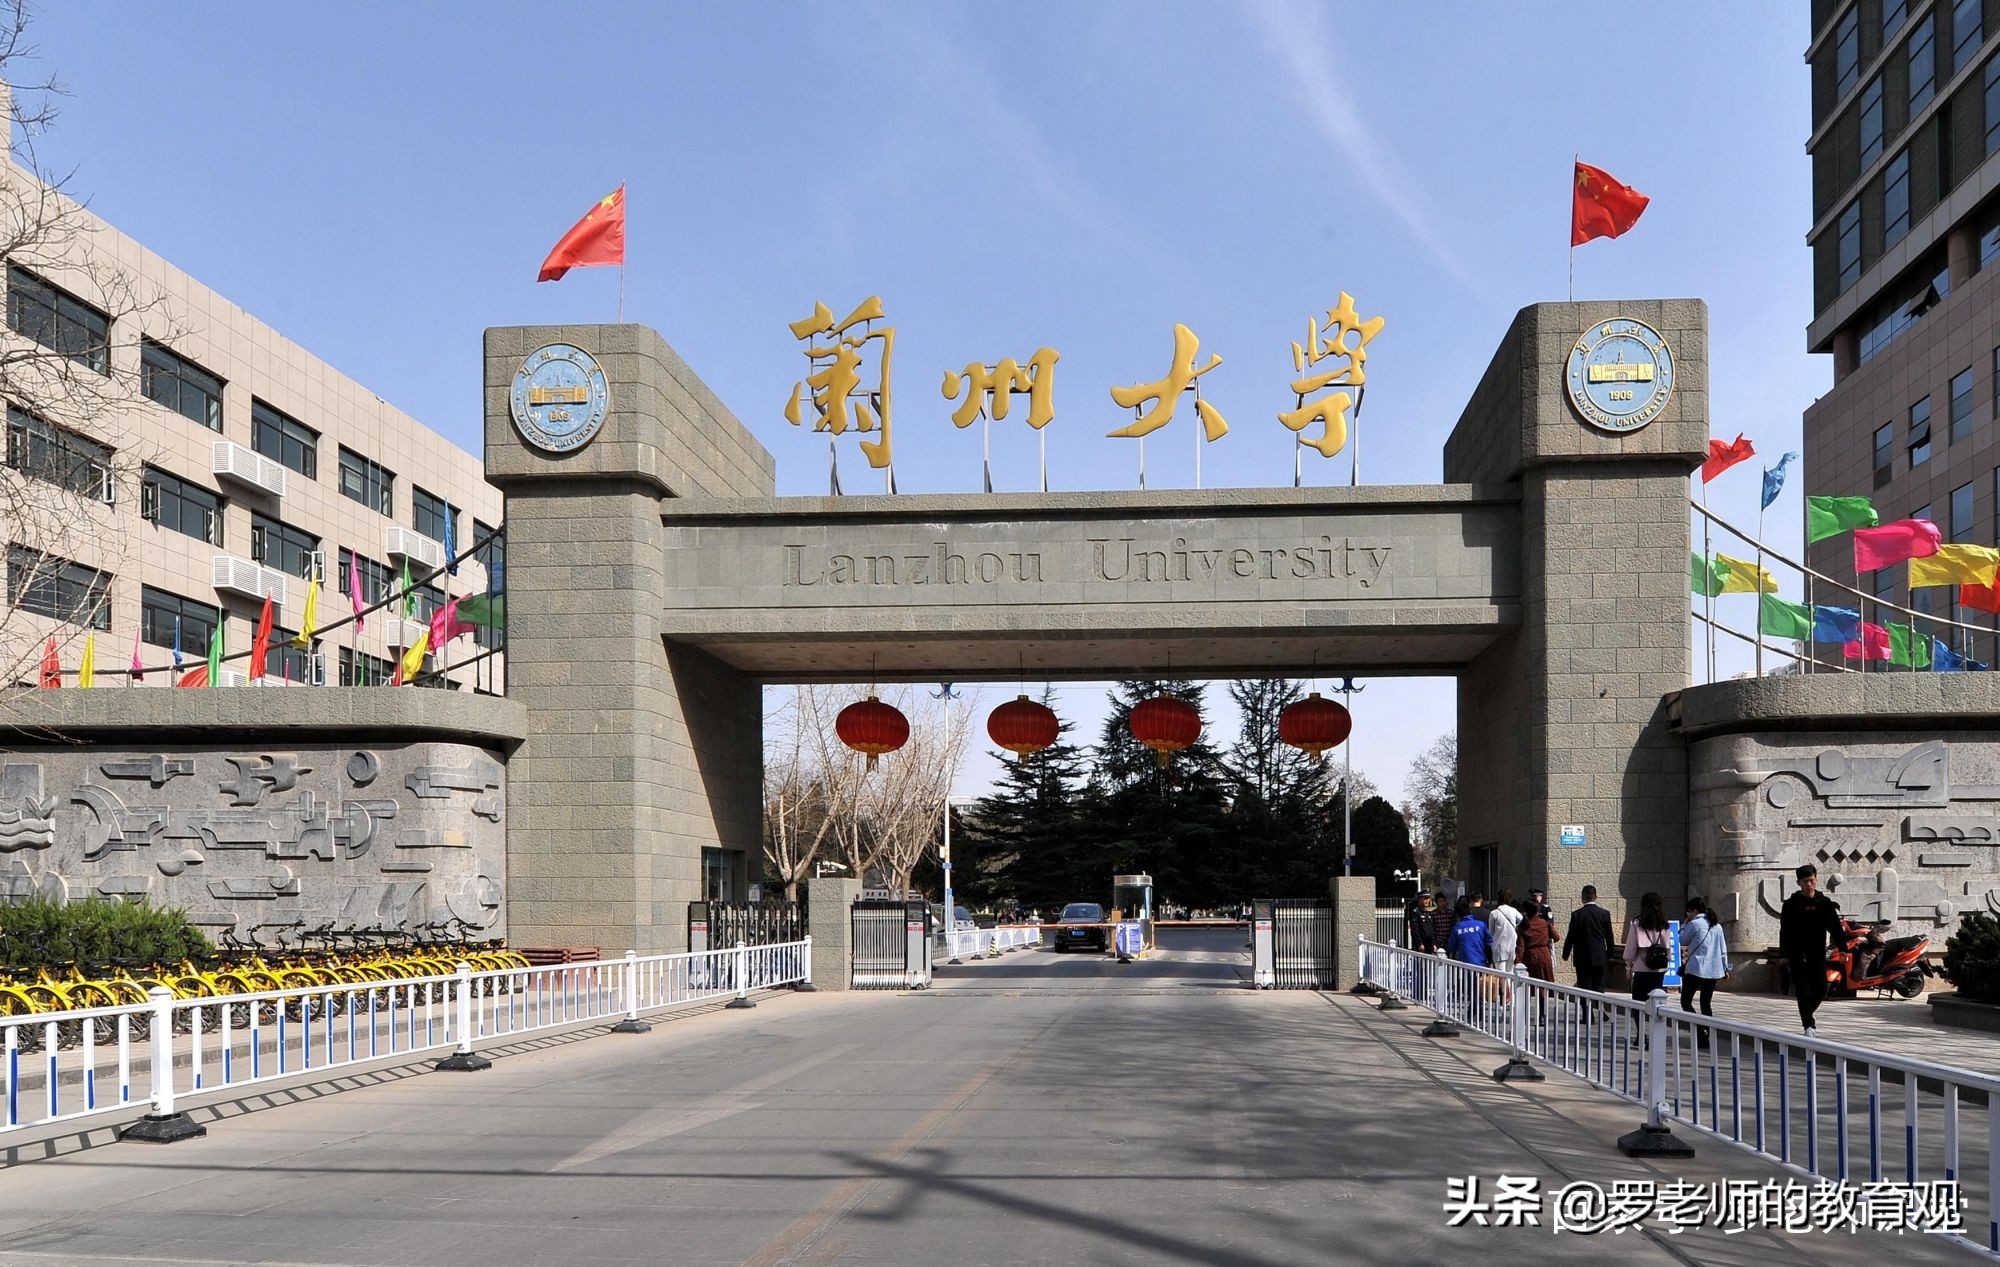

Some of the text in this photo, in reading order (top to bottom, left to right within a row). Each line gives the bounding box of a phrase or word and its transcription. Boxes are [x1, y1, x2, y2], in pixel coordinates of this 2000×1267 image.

[1575, 385, 1668, 427] LANZHOU UNIVERSITY
[1609, 390, 1633, 401] 1909
[783, 535, 1392, 589] Lanzhou University
